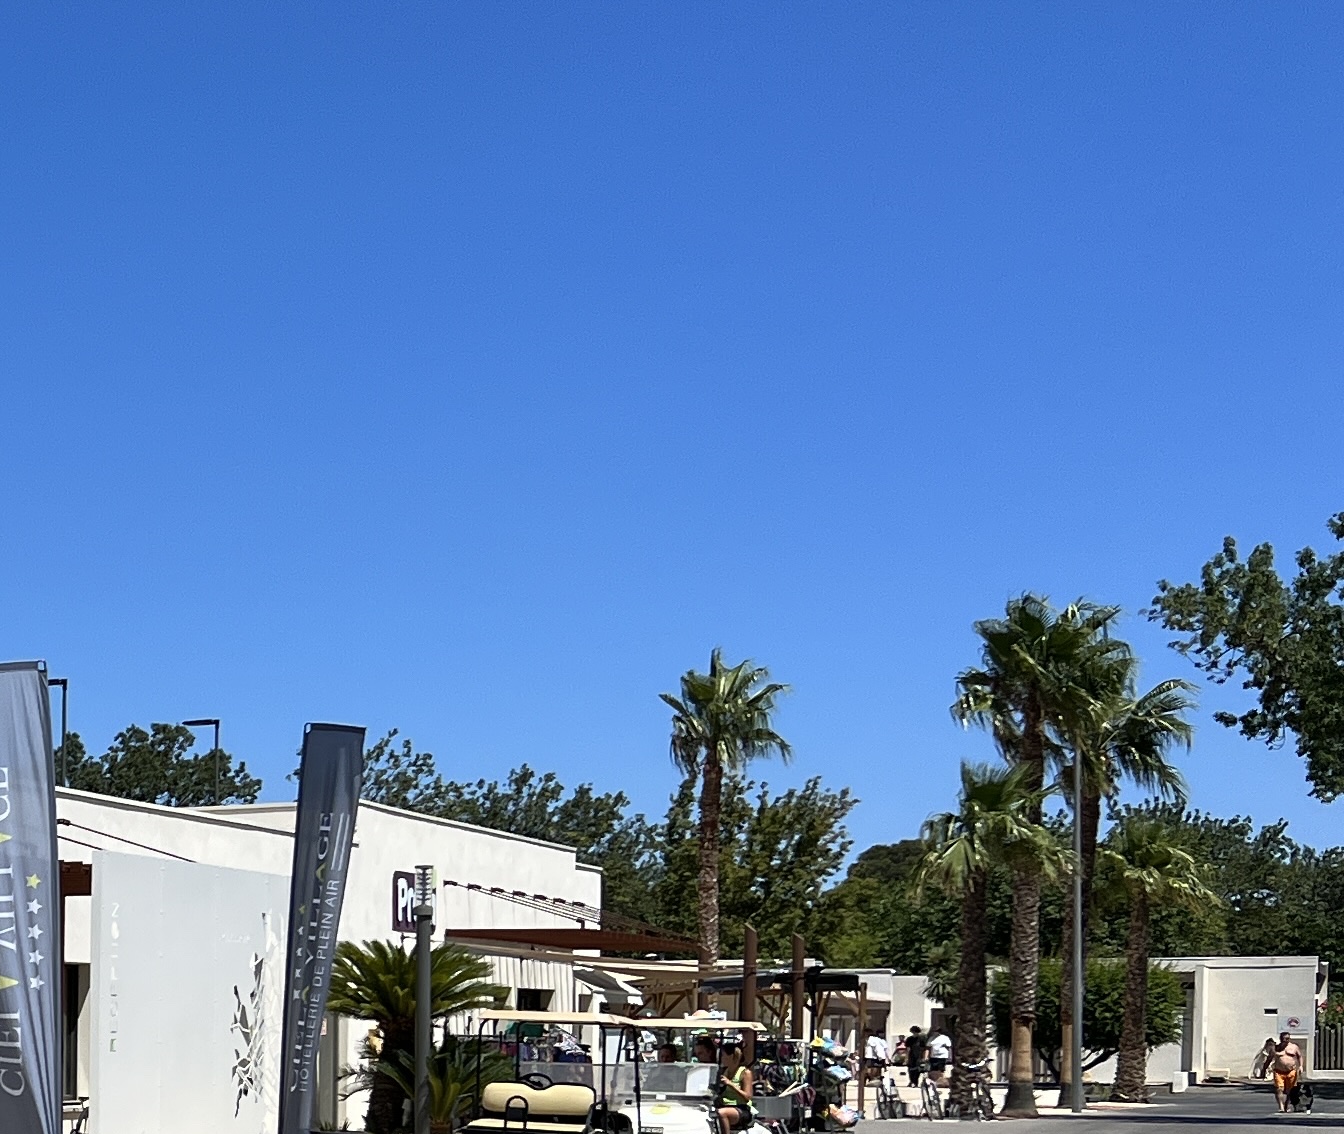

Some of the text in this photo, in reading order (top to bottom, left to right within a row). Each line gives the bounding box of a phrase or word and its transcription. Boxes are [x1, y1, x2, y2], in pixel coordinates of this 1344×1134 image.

[324, 879, 340, 908] AIR
[316, 911, 335, 960] PLEIN
[312, 965, 325, 987] DE
